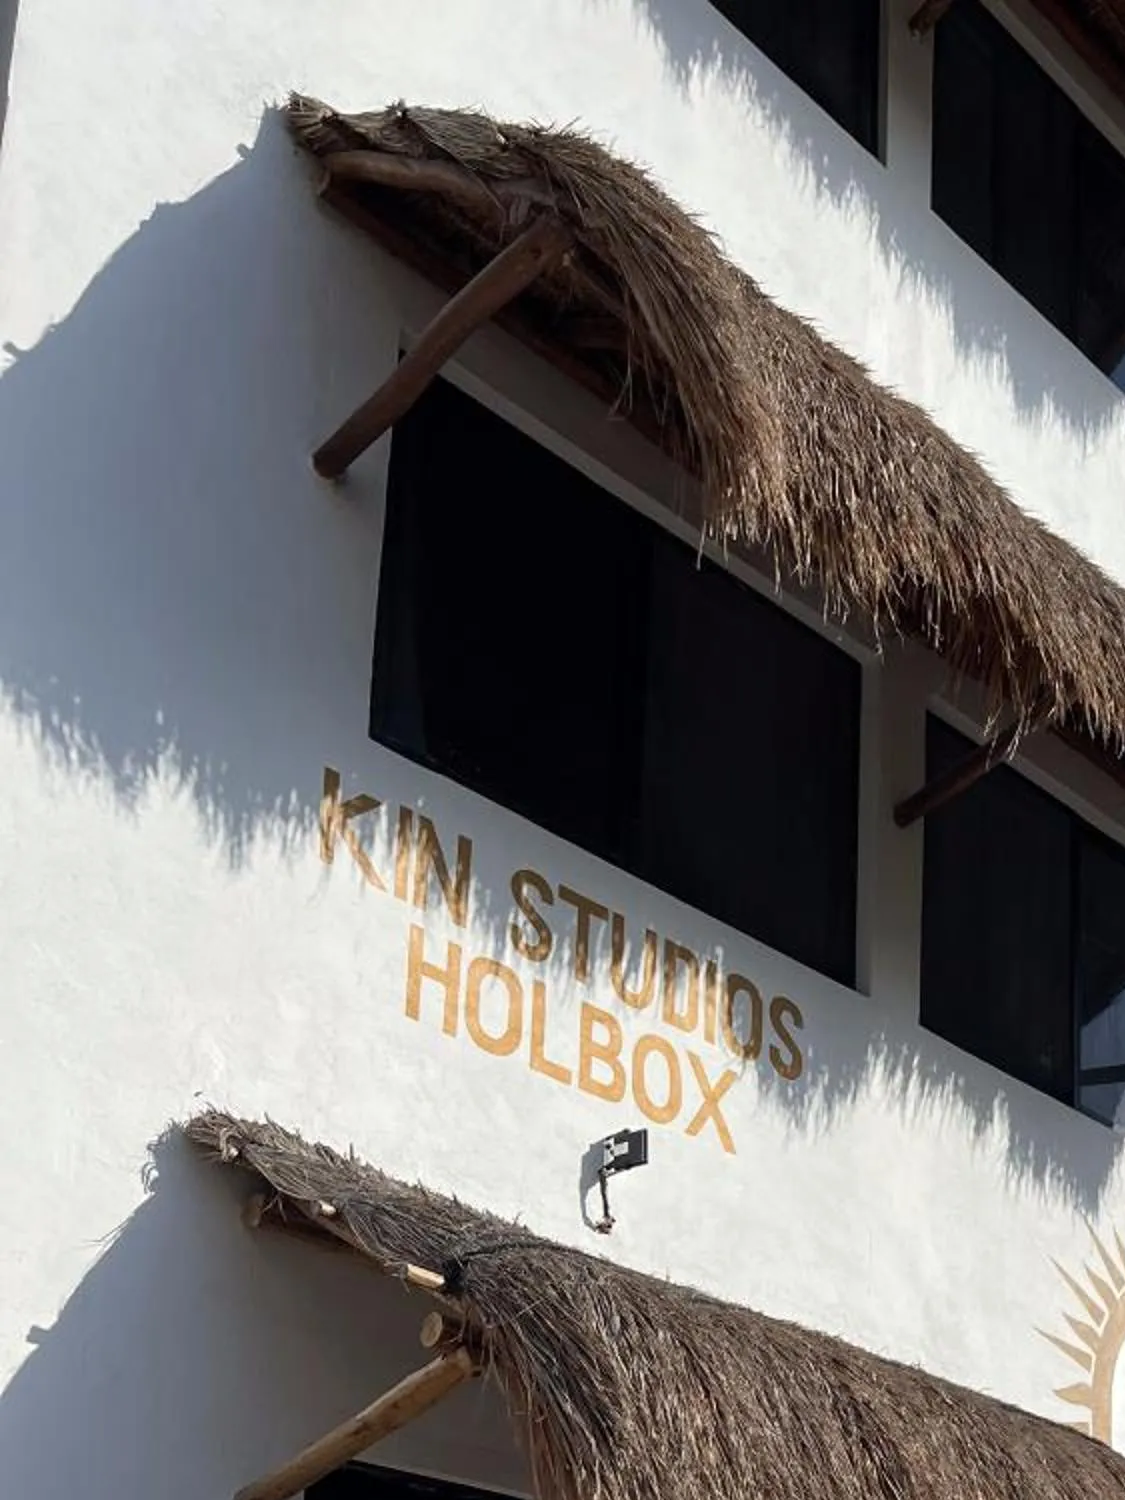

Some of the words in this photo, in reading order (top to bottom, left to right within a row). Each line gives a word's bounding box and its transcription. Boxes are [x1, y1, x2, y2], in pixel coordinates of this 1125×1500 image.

[320, 767, 472, 928] KIN
[510, 869, 804, 1080] STUDIOS
[405, 924, 737, 1155] HOLBOX
